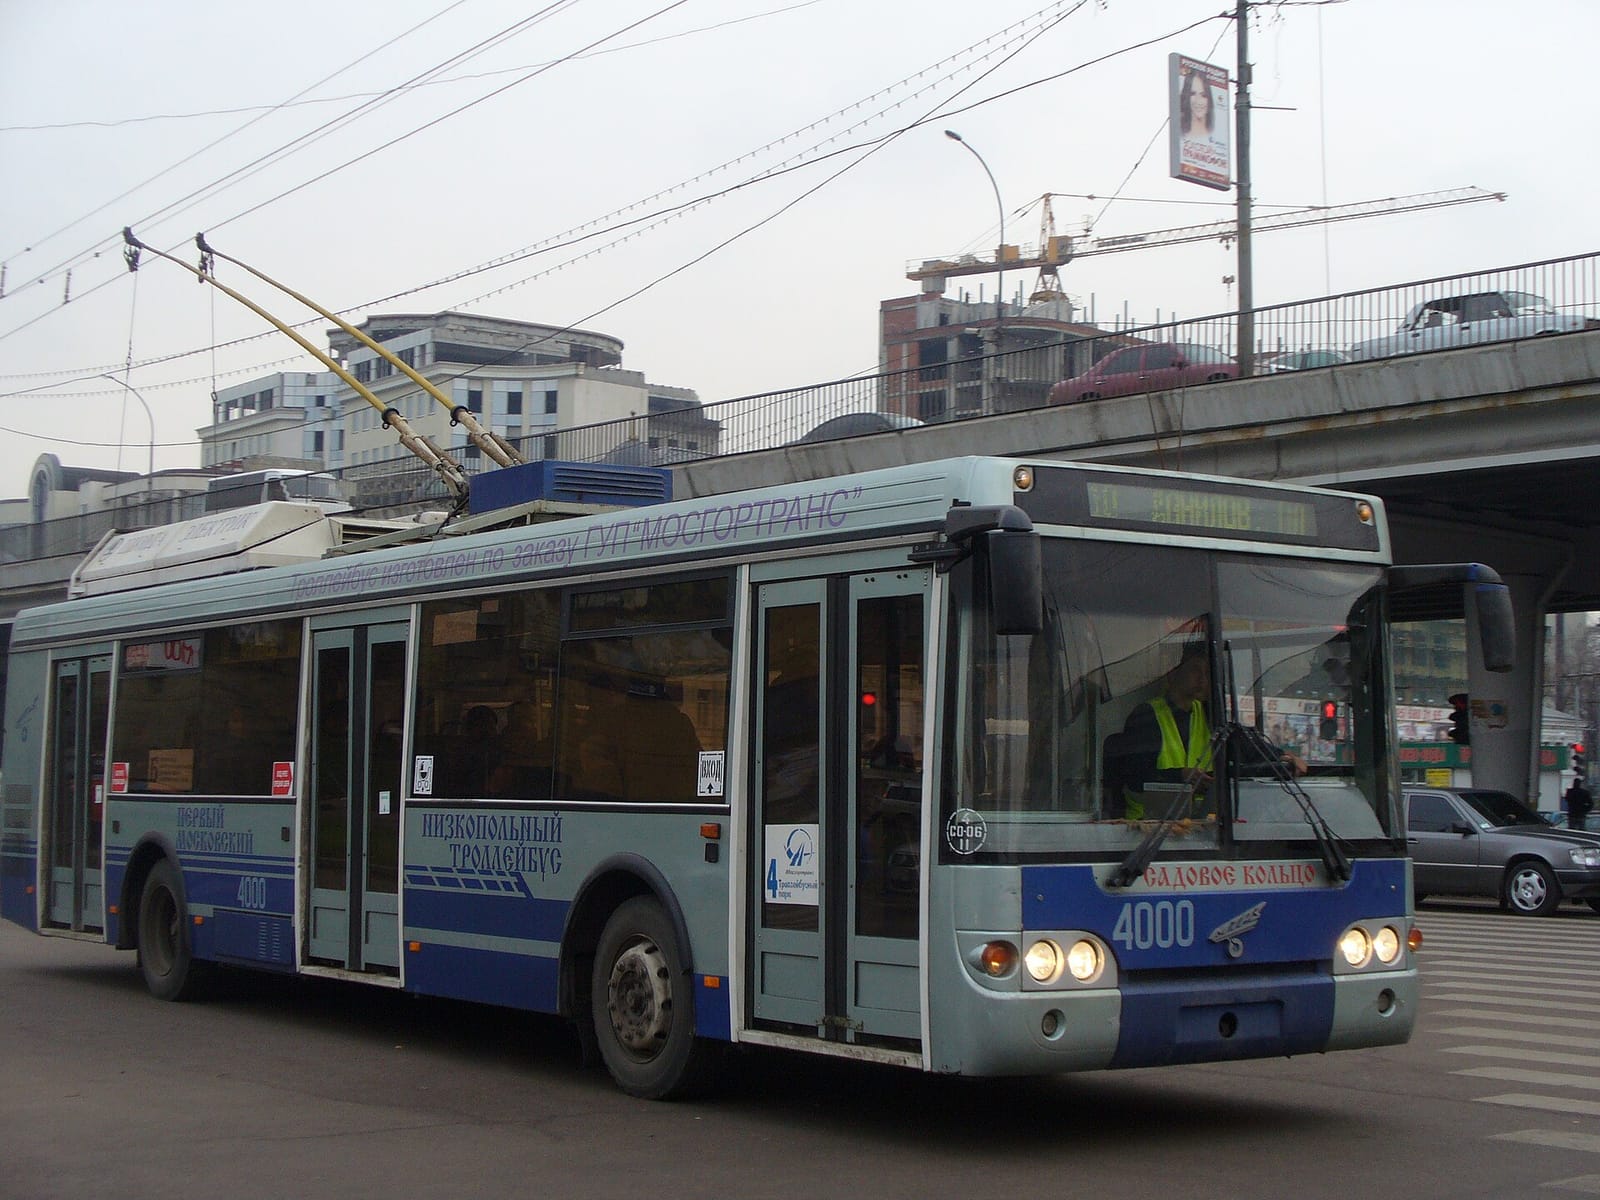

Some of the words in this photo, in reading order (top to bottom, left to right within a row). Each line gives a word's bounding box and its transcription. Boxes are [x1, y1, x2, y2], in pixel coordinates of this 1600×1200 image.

[291, 562, 377, 600] Троллейбус
[381, 557, 476, 585] изготовлен
[481, 549, 503, 577] по
[510, 536, 580, 568] заказу
[584, 520, 630, 558] ГУП
[702, 759, 721, 782] ВХОД
[421, 810, 563, 843] НИЗКОПОЛЬНЫЙ
[449, 841, 562, 882] ТРОЛЛЕЙБУС
[767, 858, 778, 898] 4
[1143, 865, 1236, 889] САДОВОЕ
[1243, 864, 1317, 886] КОЛЬЦО
[238, 876, 266, 908] 4000
[1112, 900, 1195, 951] 4000
